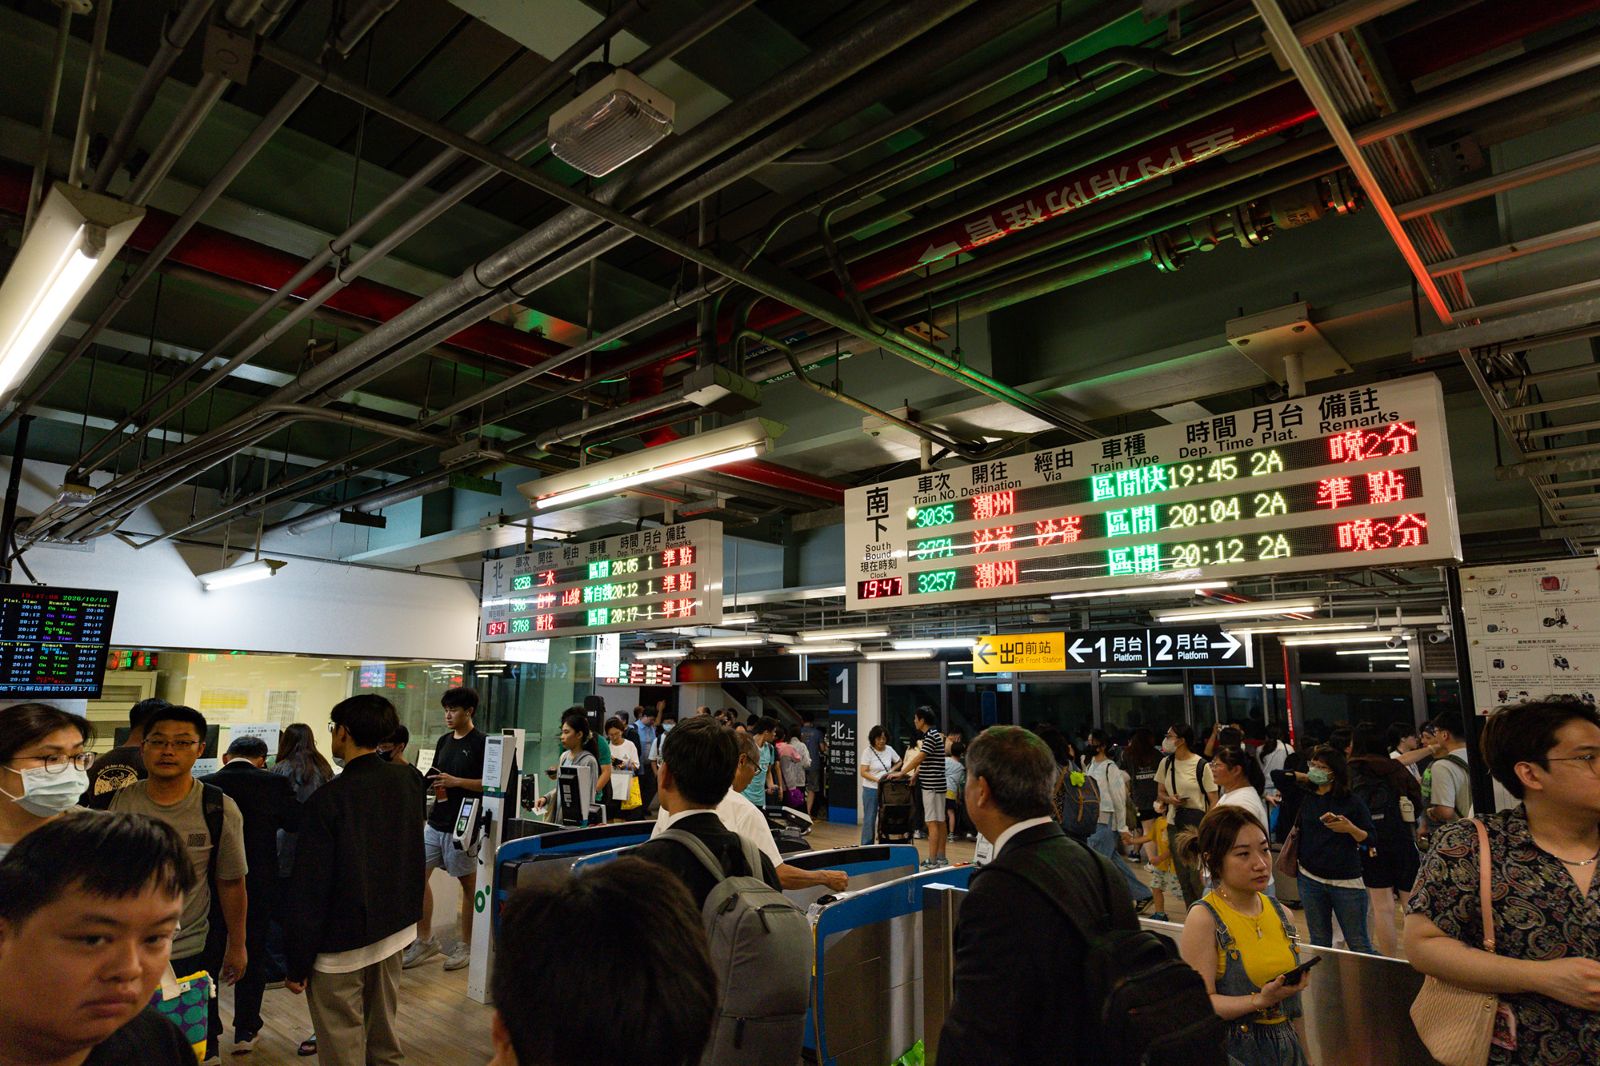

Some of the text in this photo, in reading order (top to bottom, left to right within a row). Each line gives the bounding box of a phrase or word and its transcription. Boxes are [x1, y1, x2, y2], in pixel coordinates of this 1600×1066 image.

[918, 388, 1380, 494] 車次 開往 經由 車種 時間 月台 備註
[913, 411, 1400, 504] Train NO. Destination Via Train Type Dep. Time Plat. Remarks
[916, 422, 1417, 527] 3035 潮州 區間快 19:45 2A 晚2分
[866, 486, 889, 542] 南下
[918, 538, 953, 560] 3771
[1036, 516, 1082, 546] 沙崙
[1106, 504, 1158, 537] 區間
[1168, 498, 1240, 528] 20:04
[1254, 492, 1287, 517] 2A
[620, 534, 638, 549] 時間
[643, 530, 661, 546] 月台
[666, 525, 686, 542] 備註
[865, 542, 892, 552] South
[861, 558, 898, 572] 現在時刻
[865, 551, 892, 561] Bound
[918, 513, 1428, 593] 3257 潮州 區間 20:12 2A 晚3分
[493, 561, 503, 598] 北上
[514, 576, 531, 590] 3258
[538, 570, 555, 586] 二水
[589, 561, 608, 580] 區間
[612, 558, 638, 576] 20:05
[648, 556, 653, 570] 1
[612, 582, 638, 599] 20:12
[647, 580, 653, 595] 1
[863, 578, 902, 598] 19:47
[588, 608, 608, 626] 區間
[647, 605, 653, 620] 1
[1000, 641, 1051, 664] 出口前站
[1094, 634, 1208, 662] 1 月台 2 月台
[1114, 651, 1209, 662] Platform Platform
[716, 661, 740, 679] 1 月台
[835, 668, 849, 704] 1
[831, 721, 854, 740] 北上
